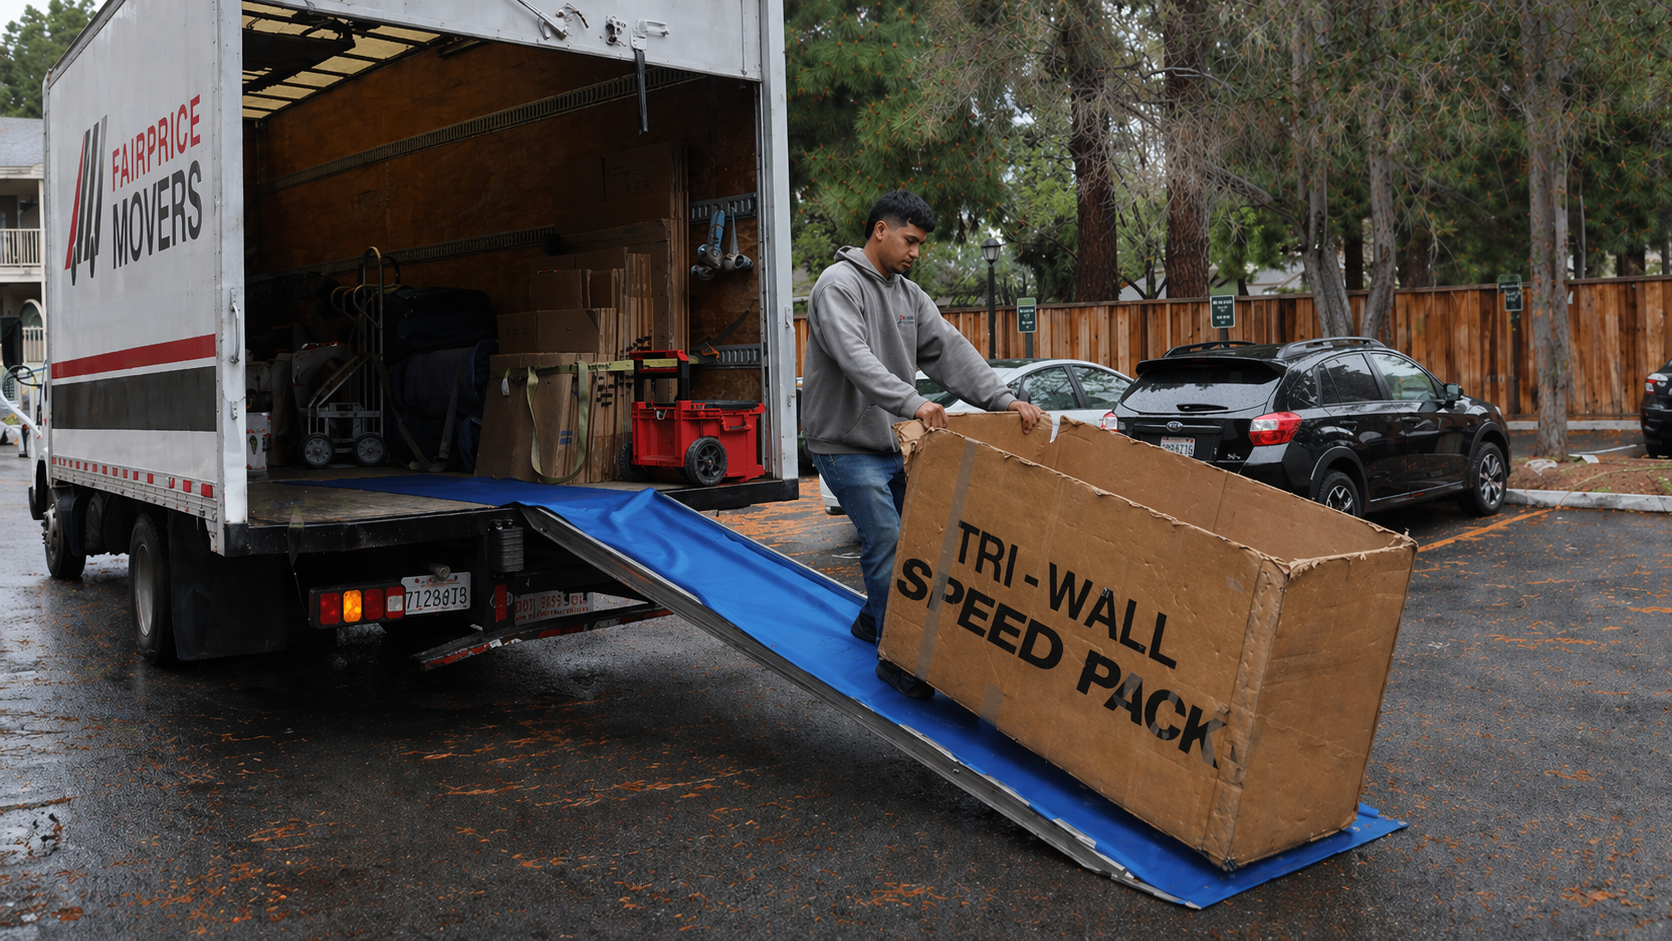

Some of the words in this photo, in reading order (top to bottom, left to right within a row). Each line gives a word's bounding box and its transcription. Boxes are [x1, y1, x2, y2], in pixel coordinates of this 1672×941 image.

[112, 94, 201, 192] FAIRPRICE
[112, 160, 202, 269] MOVERS
[896, 558, 1064, 670] SPEED
[1076, 649, 1227, 770] PACK
